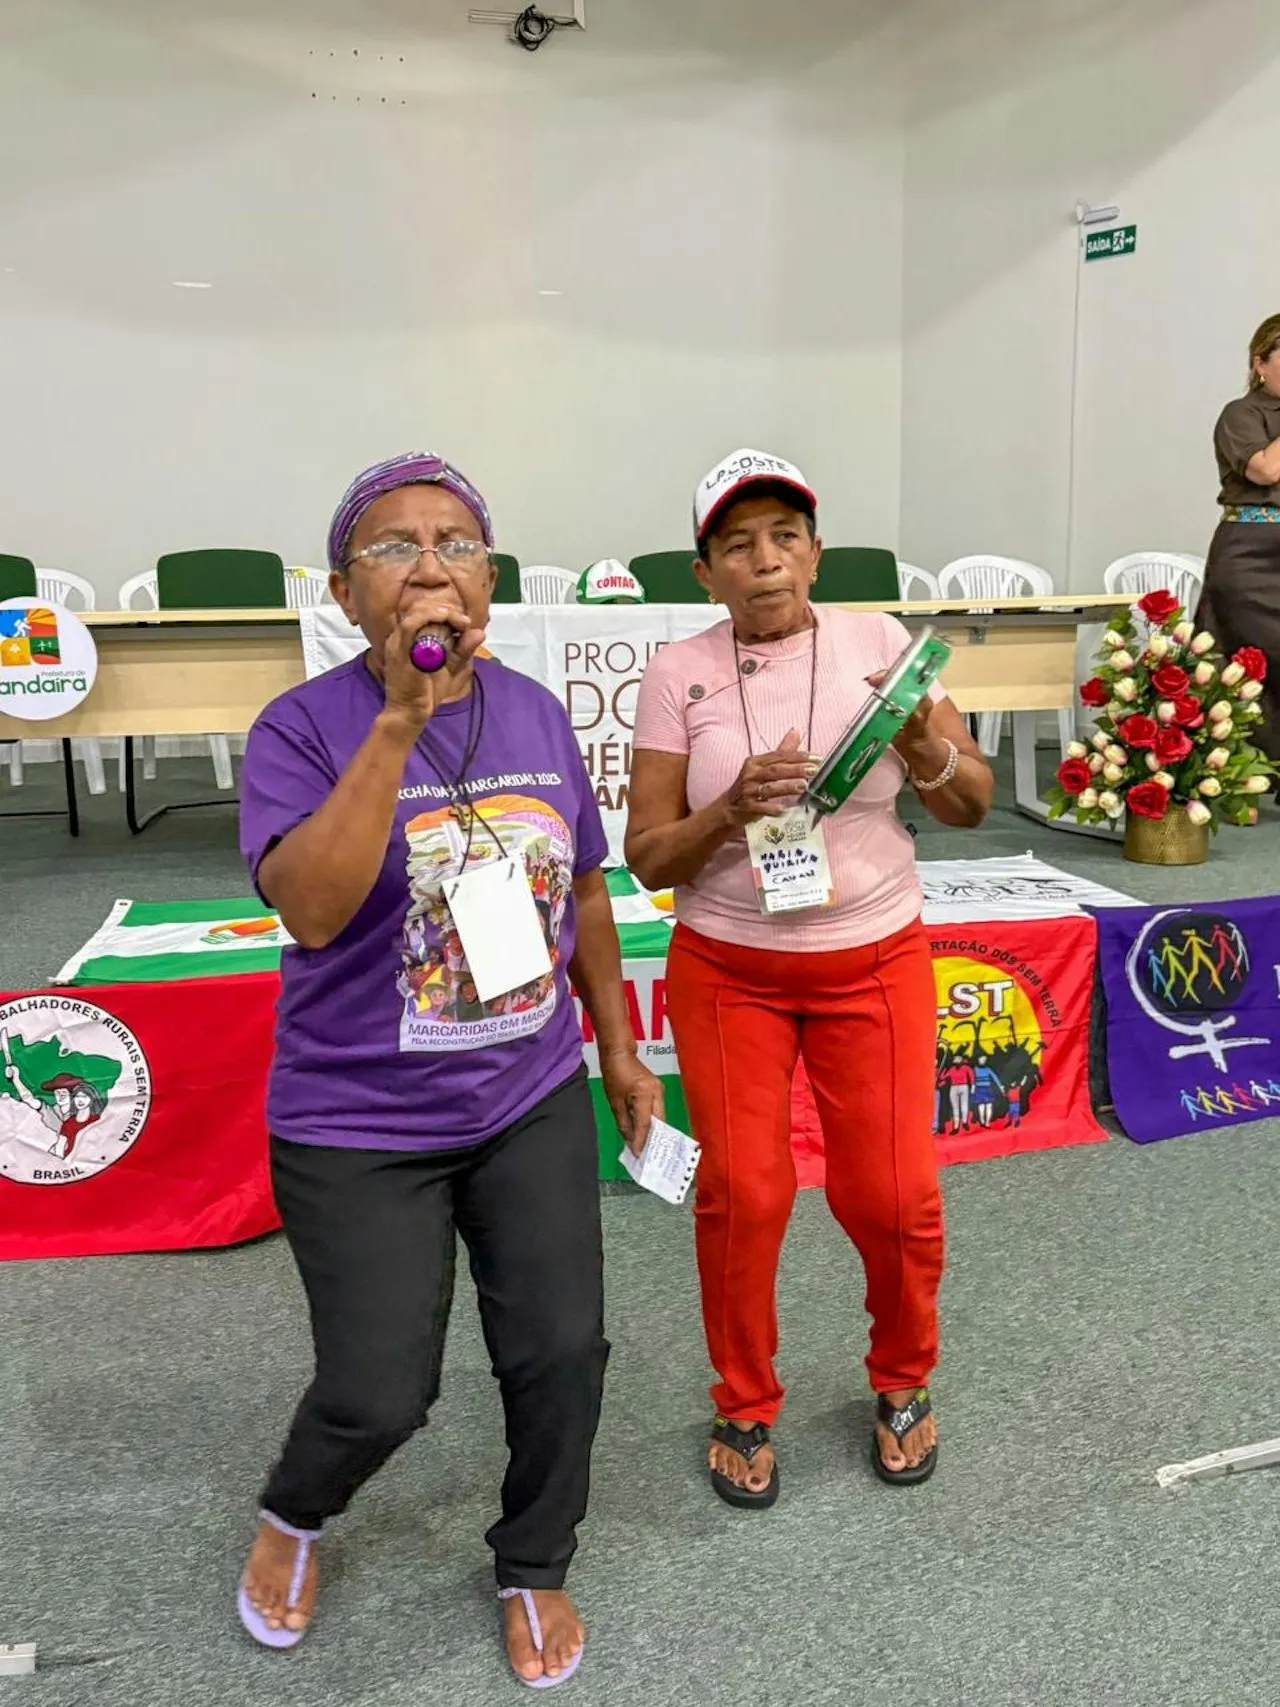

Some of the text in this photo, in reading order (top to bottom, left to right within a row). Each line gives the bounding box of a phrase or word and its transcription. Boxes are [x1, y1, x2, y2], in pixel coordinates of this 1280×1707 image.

[1087, 237, 1111, 253] SAÍDA
[706, 456, 789, 490] LACOSTE
[596, 576, 635, 589] CONTAG
[535, 772, 562, 786] 2023
[991, 947, 1018, 966] DOS
[1016, 963, 1043, 987] SEM
[1038, 985, 1063, 1028] TERRA
[102, 1017, 141, 1064] RURAIS
[408, 1022, 497, 1037] MARGARIDAS
[134, 1066, 148, 1097] SEM
[118, 1099, 146, 1143] TERRA
[33, 1166, 85, 1180] BRASIL
